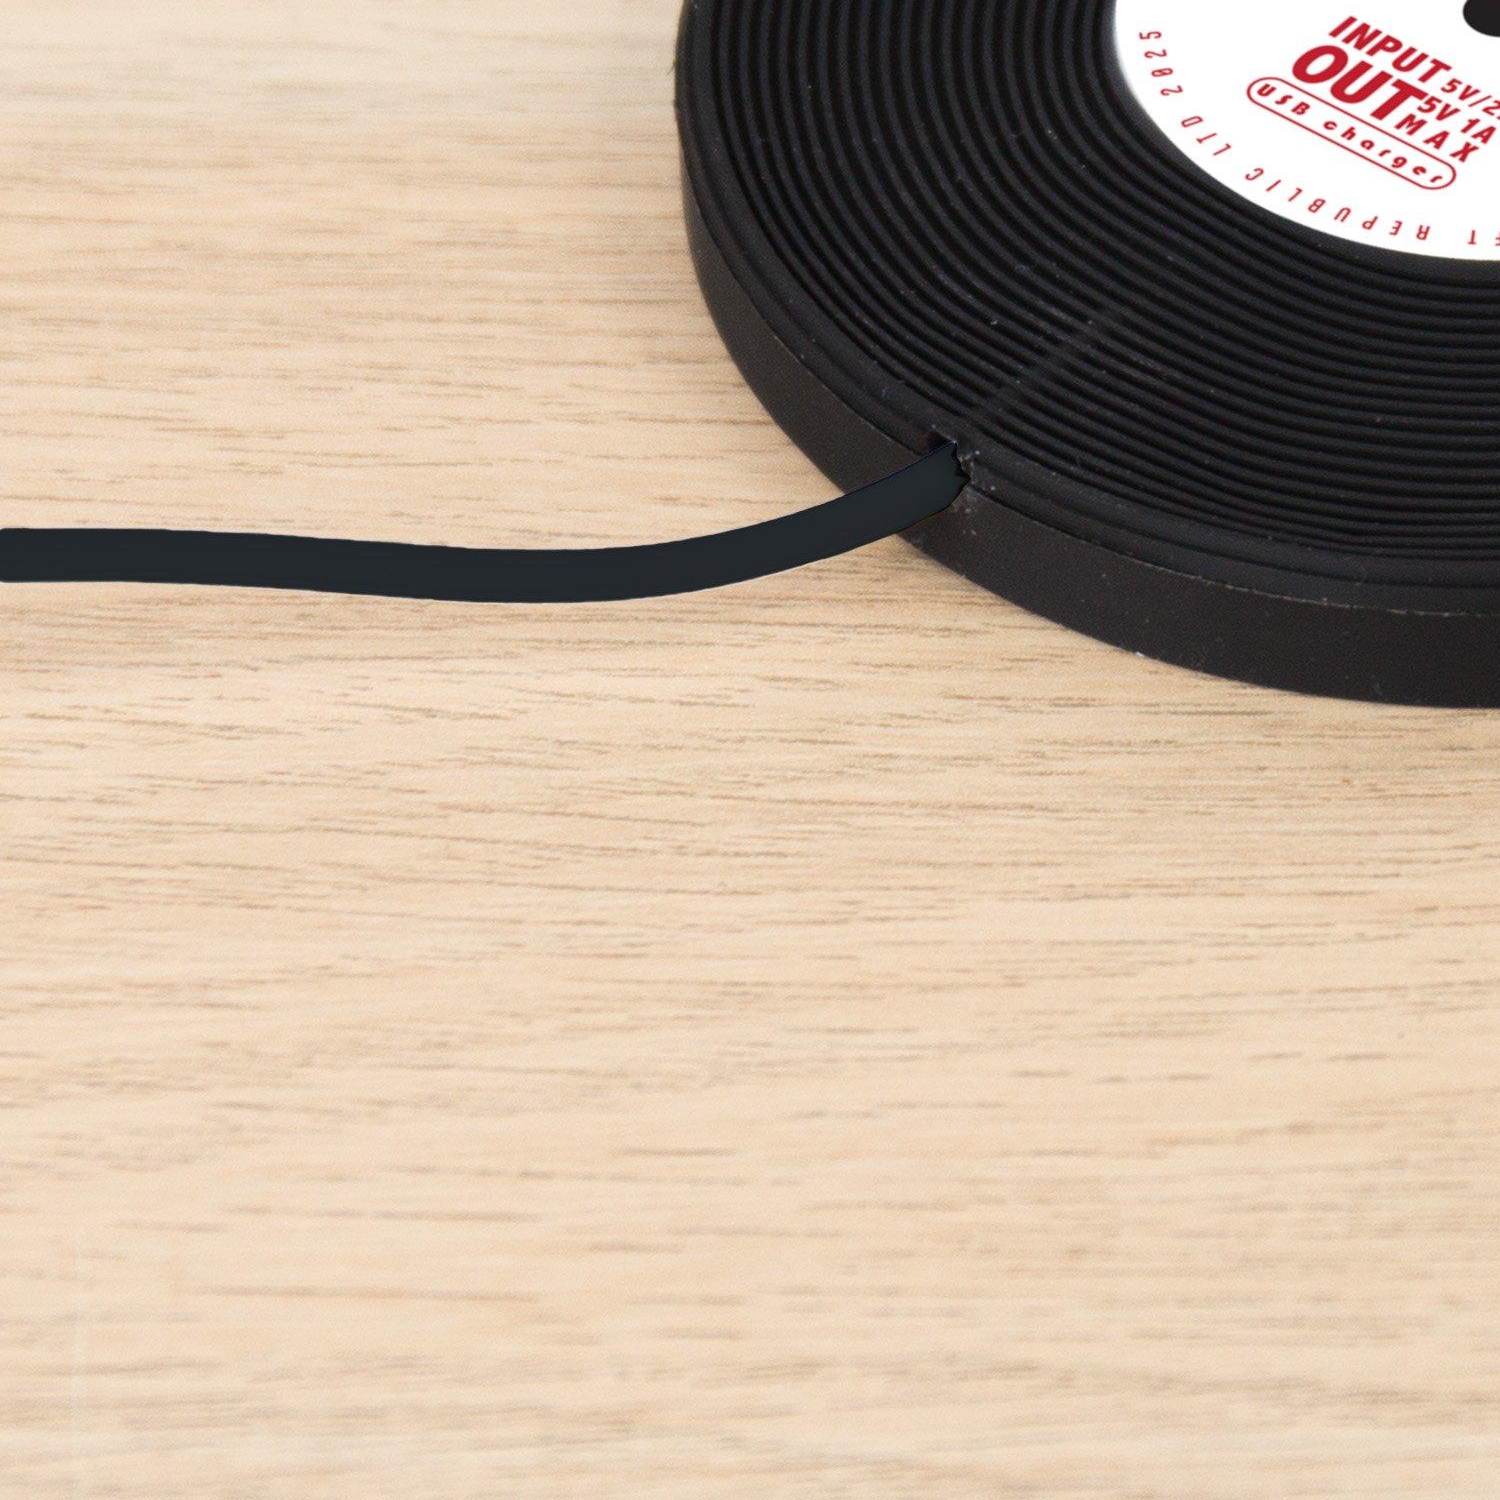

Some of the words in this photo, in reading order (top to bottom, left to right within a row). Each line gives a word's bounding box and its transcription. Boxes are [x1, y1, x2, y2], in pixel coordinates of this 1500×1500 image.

[1139, 31, 1183, 97] 2025
[1291, 44, 1429, 121] OUT
[1328, 15, 1452, 84] INPUT
[1180, 115, 1232, 156] LTD
[1256, 83, 1311, 116] USB
[1323, 120, 1443, 183] charger
[1394, 113, 1479, 163] MAX
[1416, 95, 1461, 122] 5V
[1460, 118, 1497, 145] 1A
[1245, 167, 1431, 241] REPUBLIC
